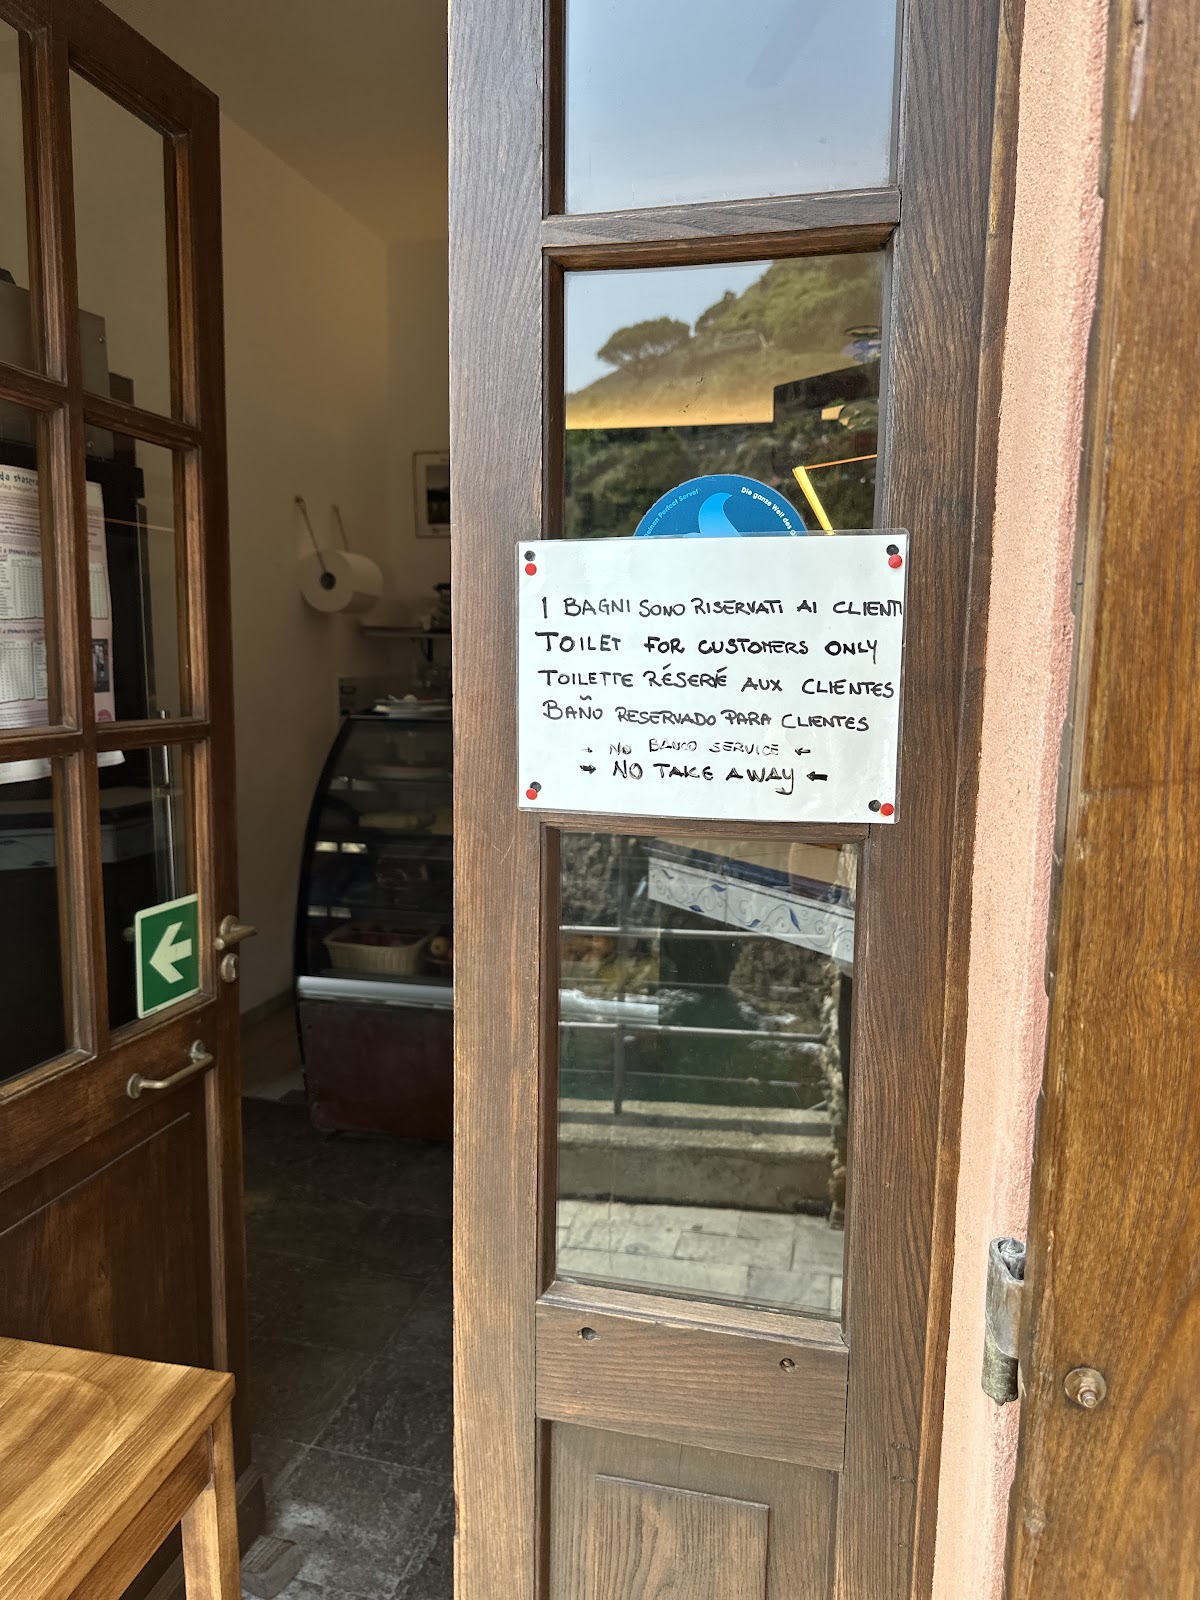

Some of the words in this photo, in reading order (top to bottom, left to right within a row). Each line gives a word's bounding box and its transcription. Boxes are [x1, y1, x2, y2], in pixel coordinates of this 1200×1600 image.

[658, 499, 679, 518] Perfect
[679, 488, 699, 502] Serve!
[740, 486, 753, 496] Die
[752, 492, 772, 507] ganze
[772, 503, 785, 518] Welt
[782, 517, 792, 530] des
[563, 597, 631, 617] BAGNI
[639, 599, 686, 618] SONO
[691, 597, 783, 616] RISERVATI
[796, 600, 817, 614] AI
[534, 631, 621, 653] TOILET
[643, 636, 686, 654] FOR
[698, 638, 809, 655] CUSTOMERS
[824, 639, 878, 665] ONLY
[537, 669, 634, 687] TOILETTE
[740, 676, 783, 692] AUX
[801, 678, 895, 698] CLIENTES
[542, 694, 604, 720] BAÑO
[615, 706, 717, 727] RESERVADO
[720, 709, 772, 726] PARA
[781, 713, 870, 732] CLIENTES
[609, 742, 632, 756] NO
[708, 741, 779, 756] SERVICE
[612, 759, 643, 780] NO
[653, 763, 714, 780] TAKE
